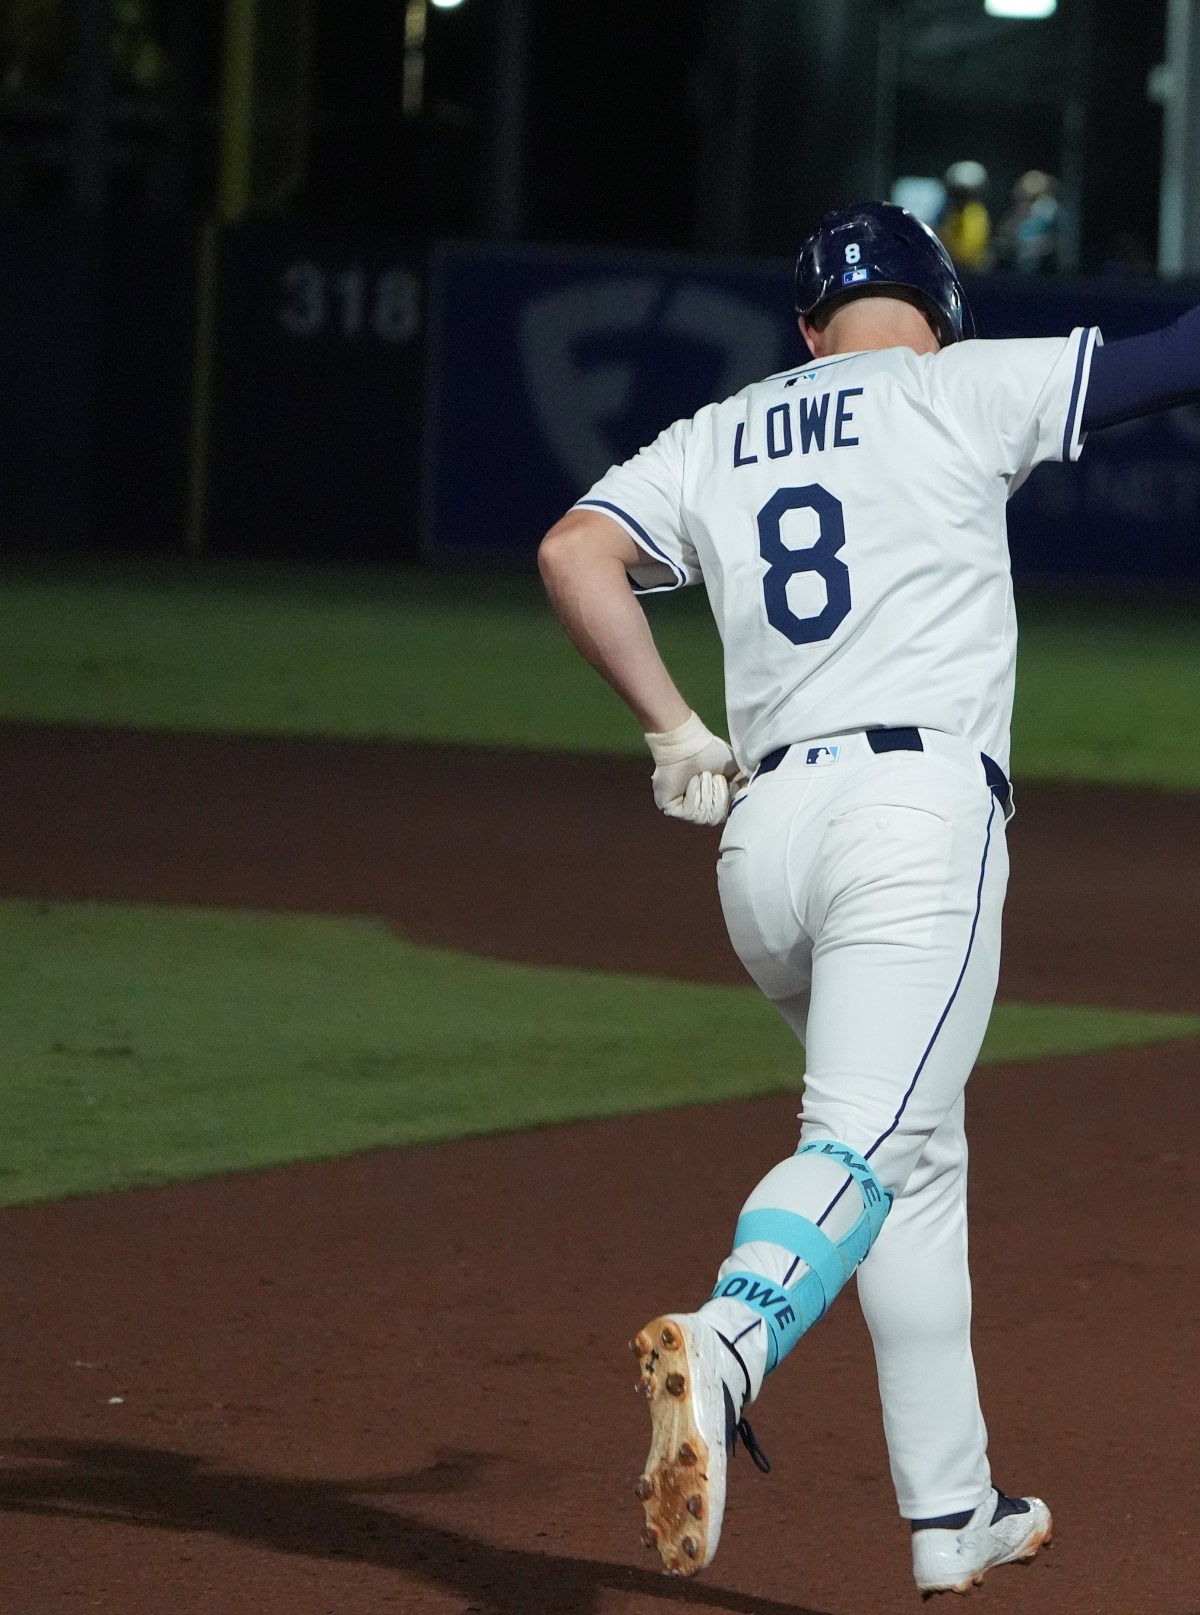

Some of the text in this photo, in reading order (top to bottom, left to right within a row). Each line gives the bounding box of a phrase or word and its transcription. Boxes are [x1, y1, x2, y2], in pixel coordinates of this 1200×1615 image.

[844, 242, 861, 265] 8
[277, 262, 423, 344] 318
[734, 387, 864, 468] LOWE
[757, 483, 852, 646] 8
